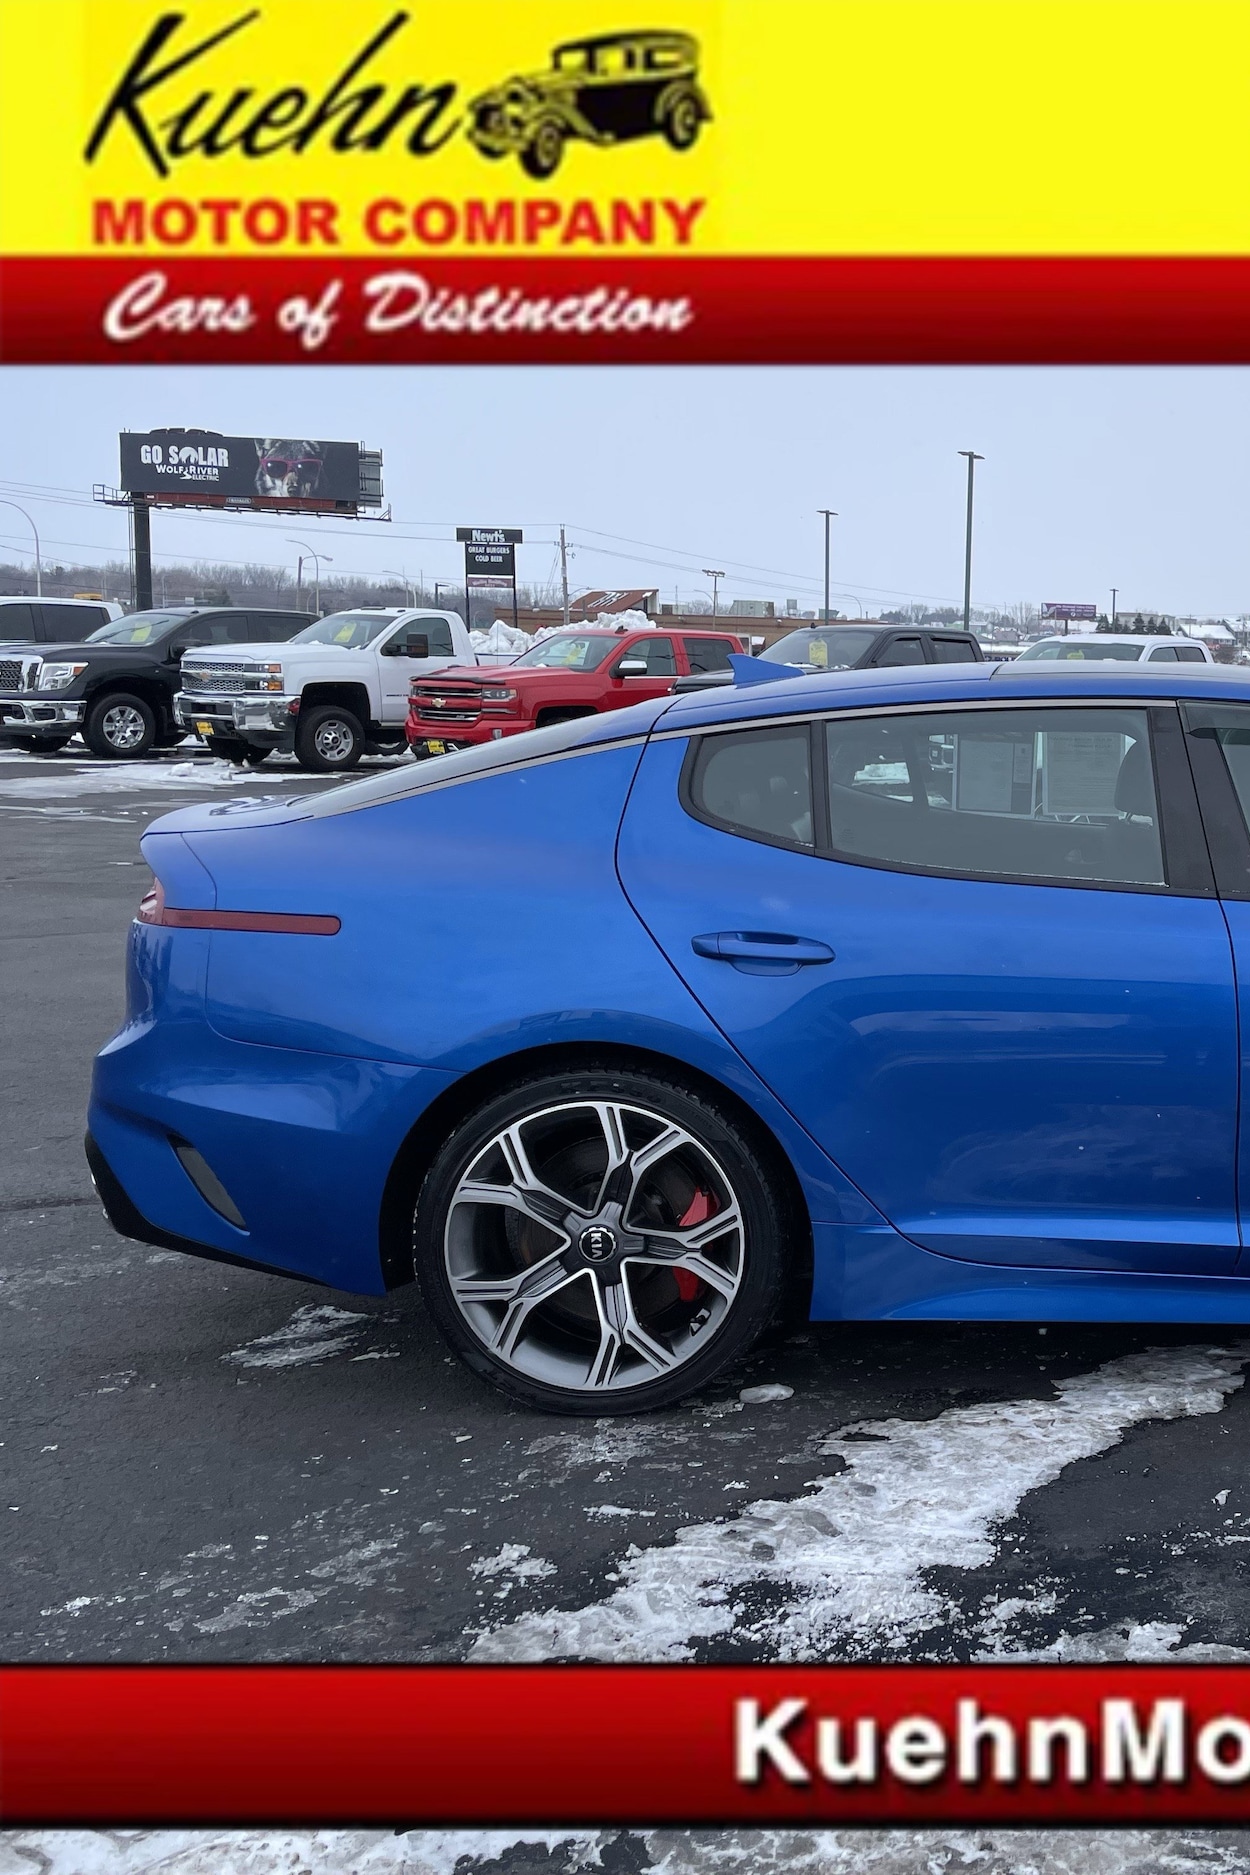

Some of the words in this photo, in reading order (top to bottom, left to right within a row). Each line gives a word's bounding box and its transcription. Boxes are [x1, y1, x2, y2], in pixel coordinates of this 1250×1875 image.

[141, 445, 162, 464] GO
[168, 445, 229, 467] SOLAR
[156, 464, 184, 474] WOLF
[189, 465, 219, 475] RIVER
[192, 474, 220, 482] ELECTRIC
[472, 529, 505, 542] Newt's
[486, 546, 510, 554] BURGERS
[591, 1233, 602, 1258] KIA
